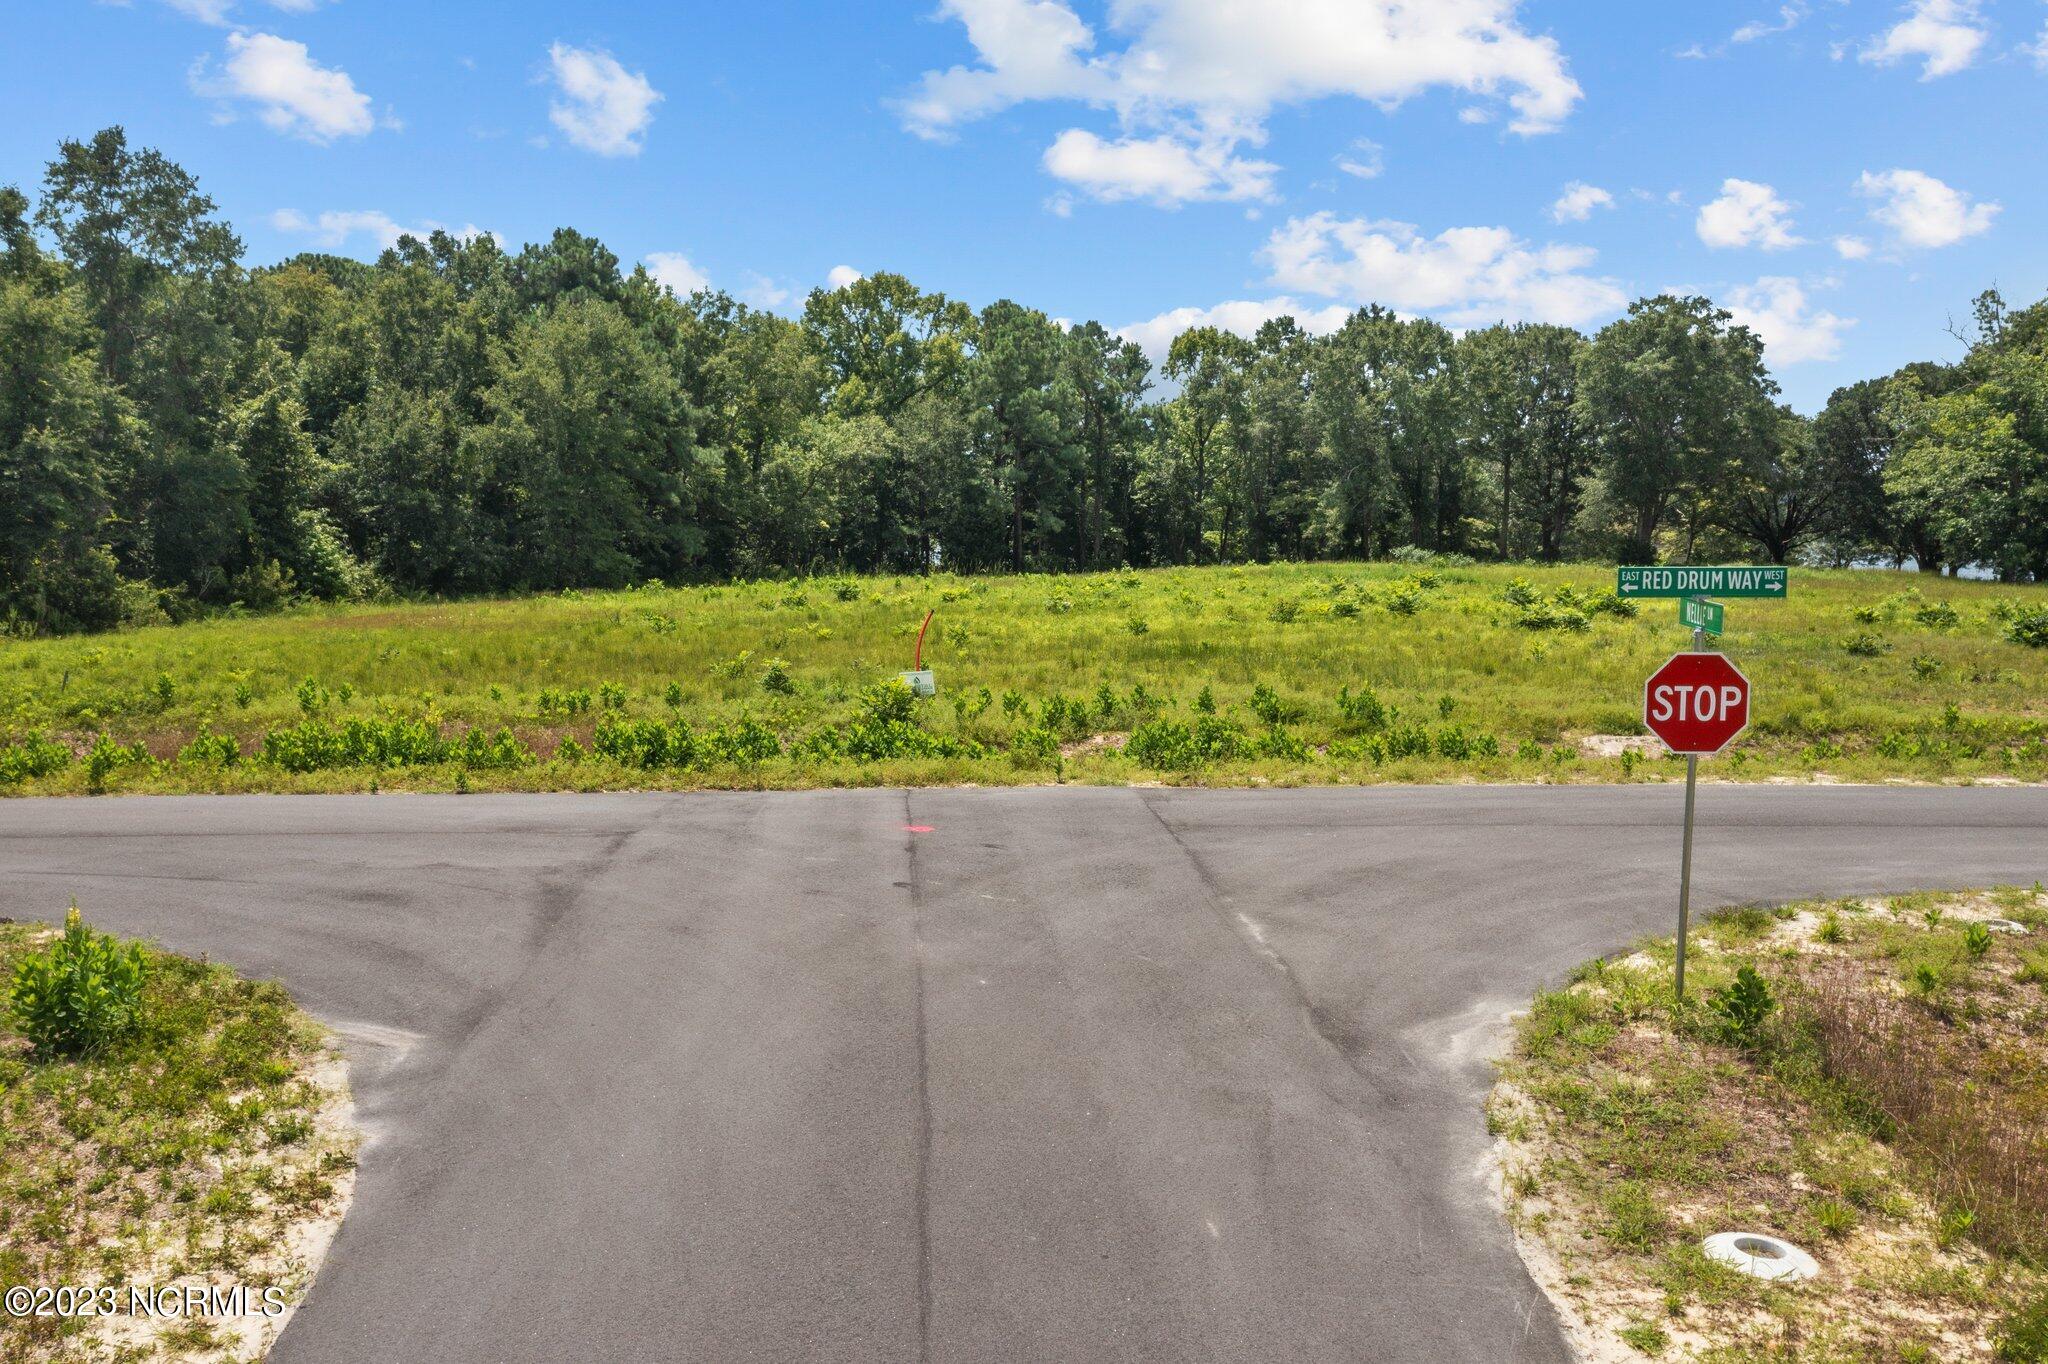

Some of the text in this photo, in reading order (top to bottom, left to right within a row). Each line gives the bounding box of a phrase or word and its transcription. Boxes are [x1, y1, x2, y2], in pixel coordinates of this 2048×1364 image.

[1621, 570, 1785, 590] EAST RED DRUM WAY WEST
[1652, 685, 1742, 721] STOP
